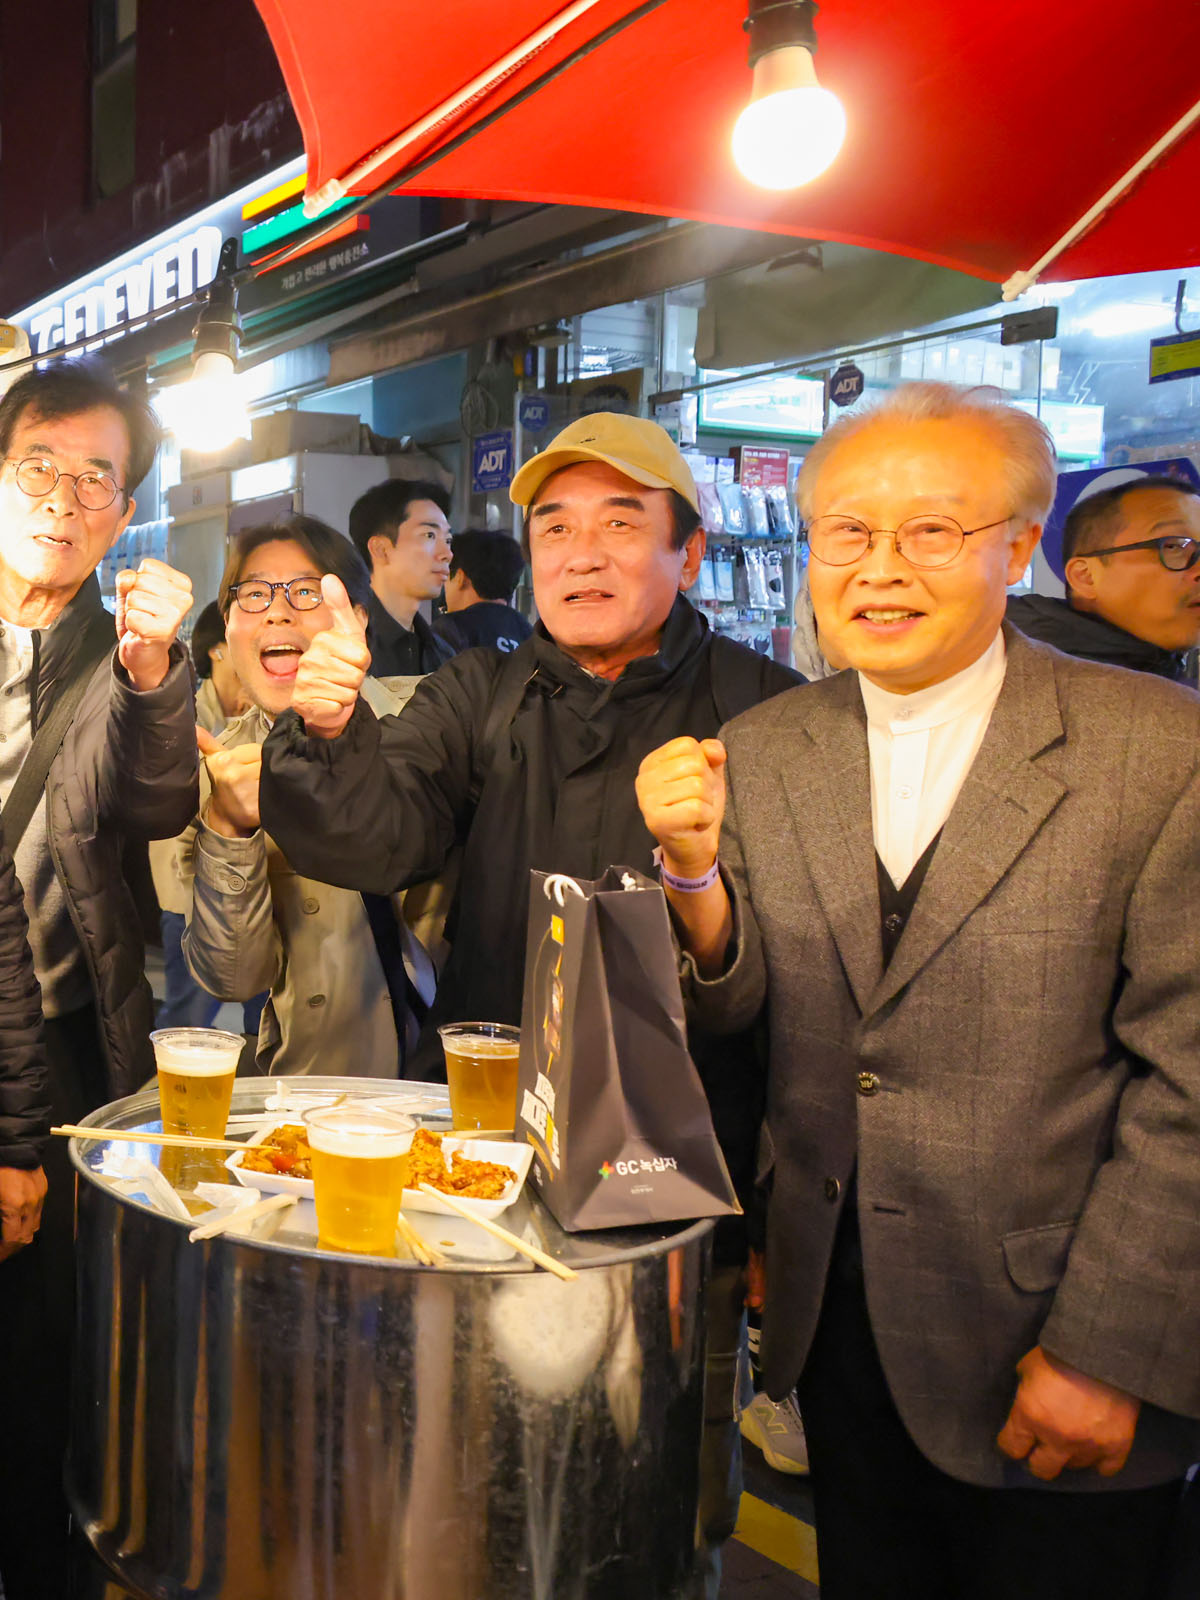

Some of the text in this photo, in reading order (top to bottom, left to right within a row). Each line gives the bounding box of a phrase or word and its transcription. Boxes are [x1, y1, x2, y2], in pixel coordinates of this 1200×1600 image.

[834, 376, 860, 395] ADT
[523, 406, 545, 420] ADT
[478, 449, 507, 474] ADT
